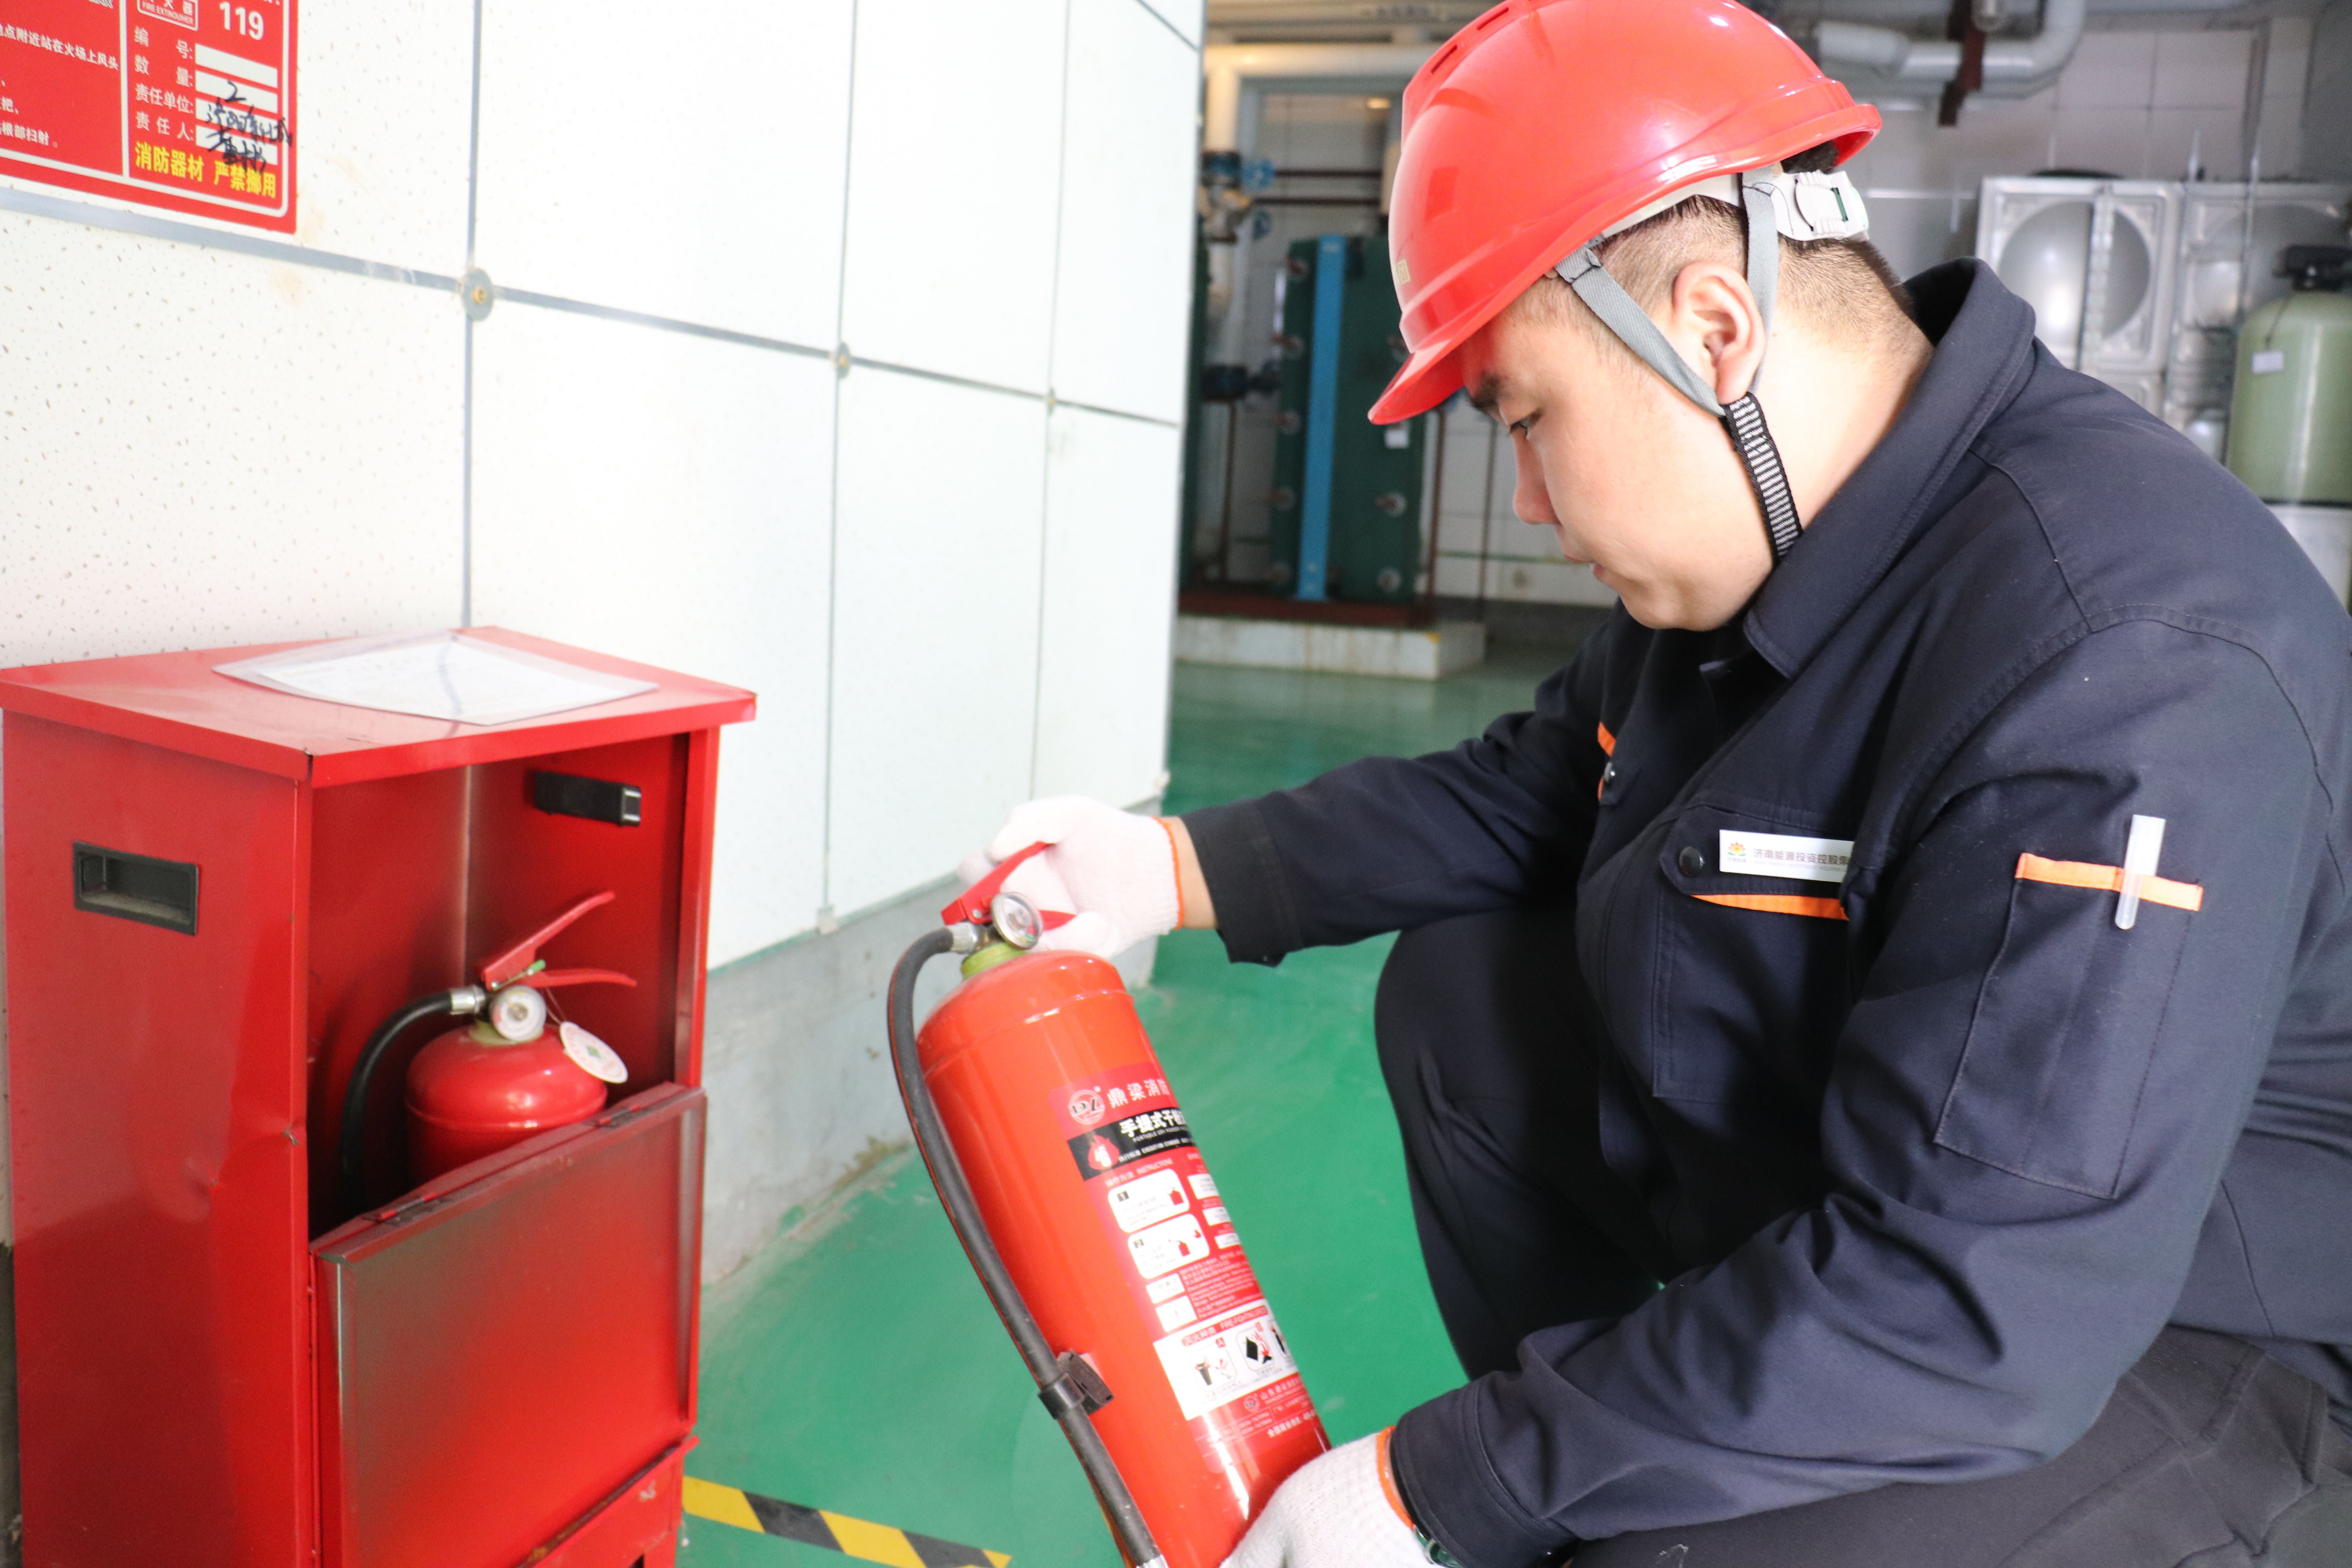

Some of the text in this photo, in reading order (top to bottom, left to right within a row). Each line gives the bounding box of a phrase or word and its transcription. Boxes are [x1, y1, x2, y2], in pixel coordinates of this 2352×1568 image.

[143, 0, 193, 16] 火器
[220, 1, 264, 40] 119
[0, 120, 58, 148] 根部扫射。
[135, 142, 204, 183] 消防器材
[214, 160, 276, 198] 严禁挪用
